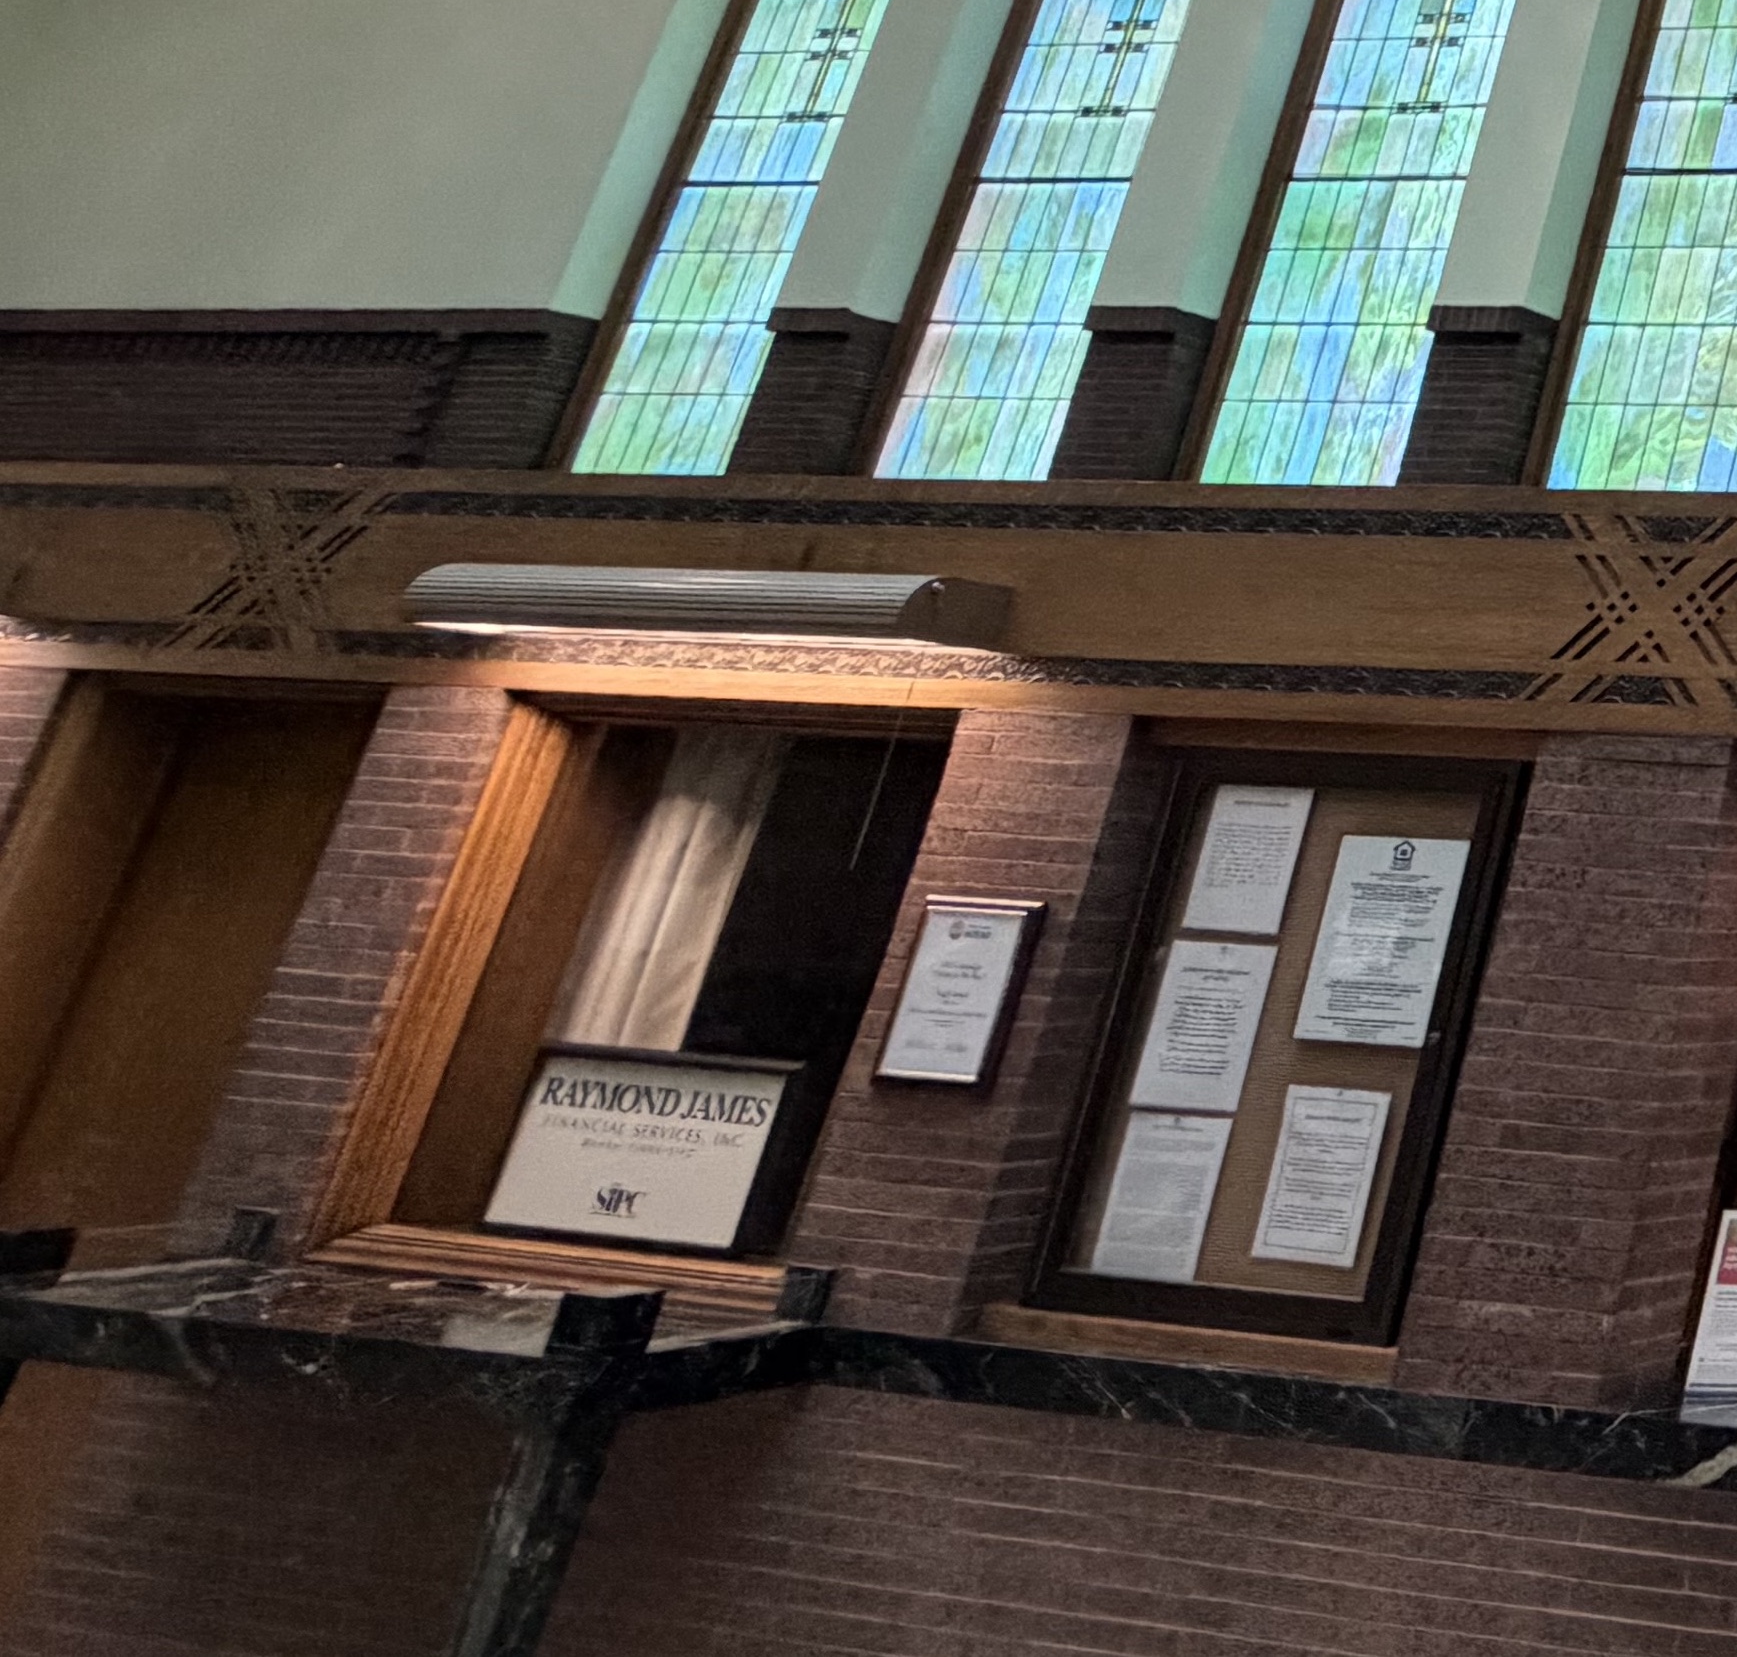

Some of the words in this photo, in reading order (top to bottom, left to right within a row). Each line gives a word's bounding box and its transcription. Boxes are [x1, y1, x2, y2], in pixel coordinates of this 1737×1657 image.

[539, 1076, 682, 1118] RAYMOND
[680, 1089, 773, 1128] JAMES
[592, 1186, 647, 1215] SIPC
